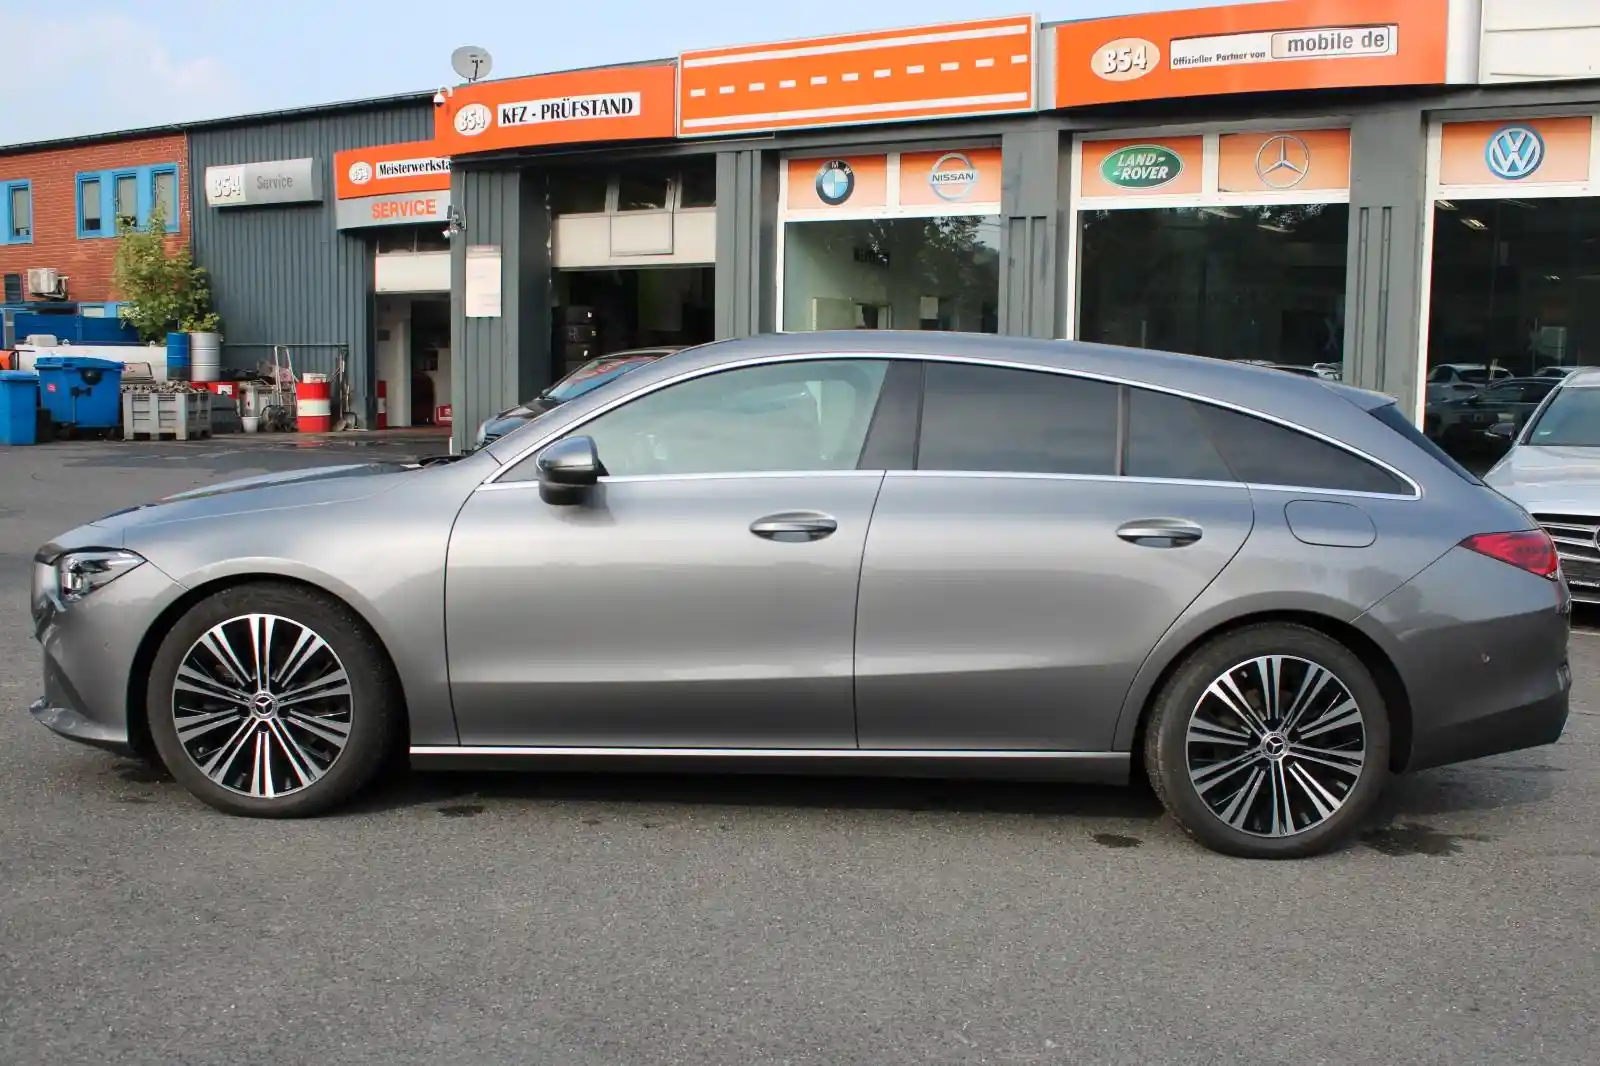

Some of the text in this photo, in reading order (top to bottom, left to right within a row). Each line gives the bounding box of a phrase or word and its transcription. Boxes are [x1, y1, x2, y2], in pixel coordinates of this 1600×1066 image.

[1287, 30, 1385, 53] mobile de
[1172, 50, 1266, 66] Offizieller Partner von
[502, 107, 528, 124] KFZ
[540, 98, 634, 120] PRÜFSTAND
[256, 174, 294, 190] Service
[932, 172, 974, 182] NISSAN
[371, 199, 437, 219] SERVICE
